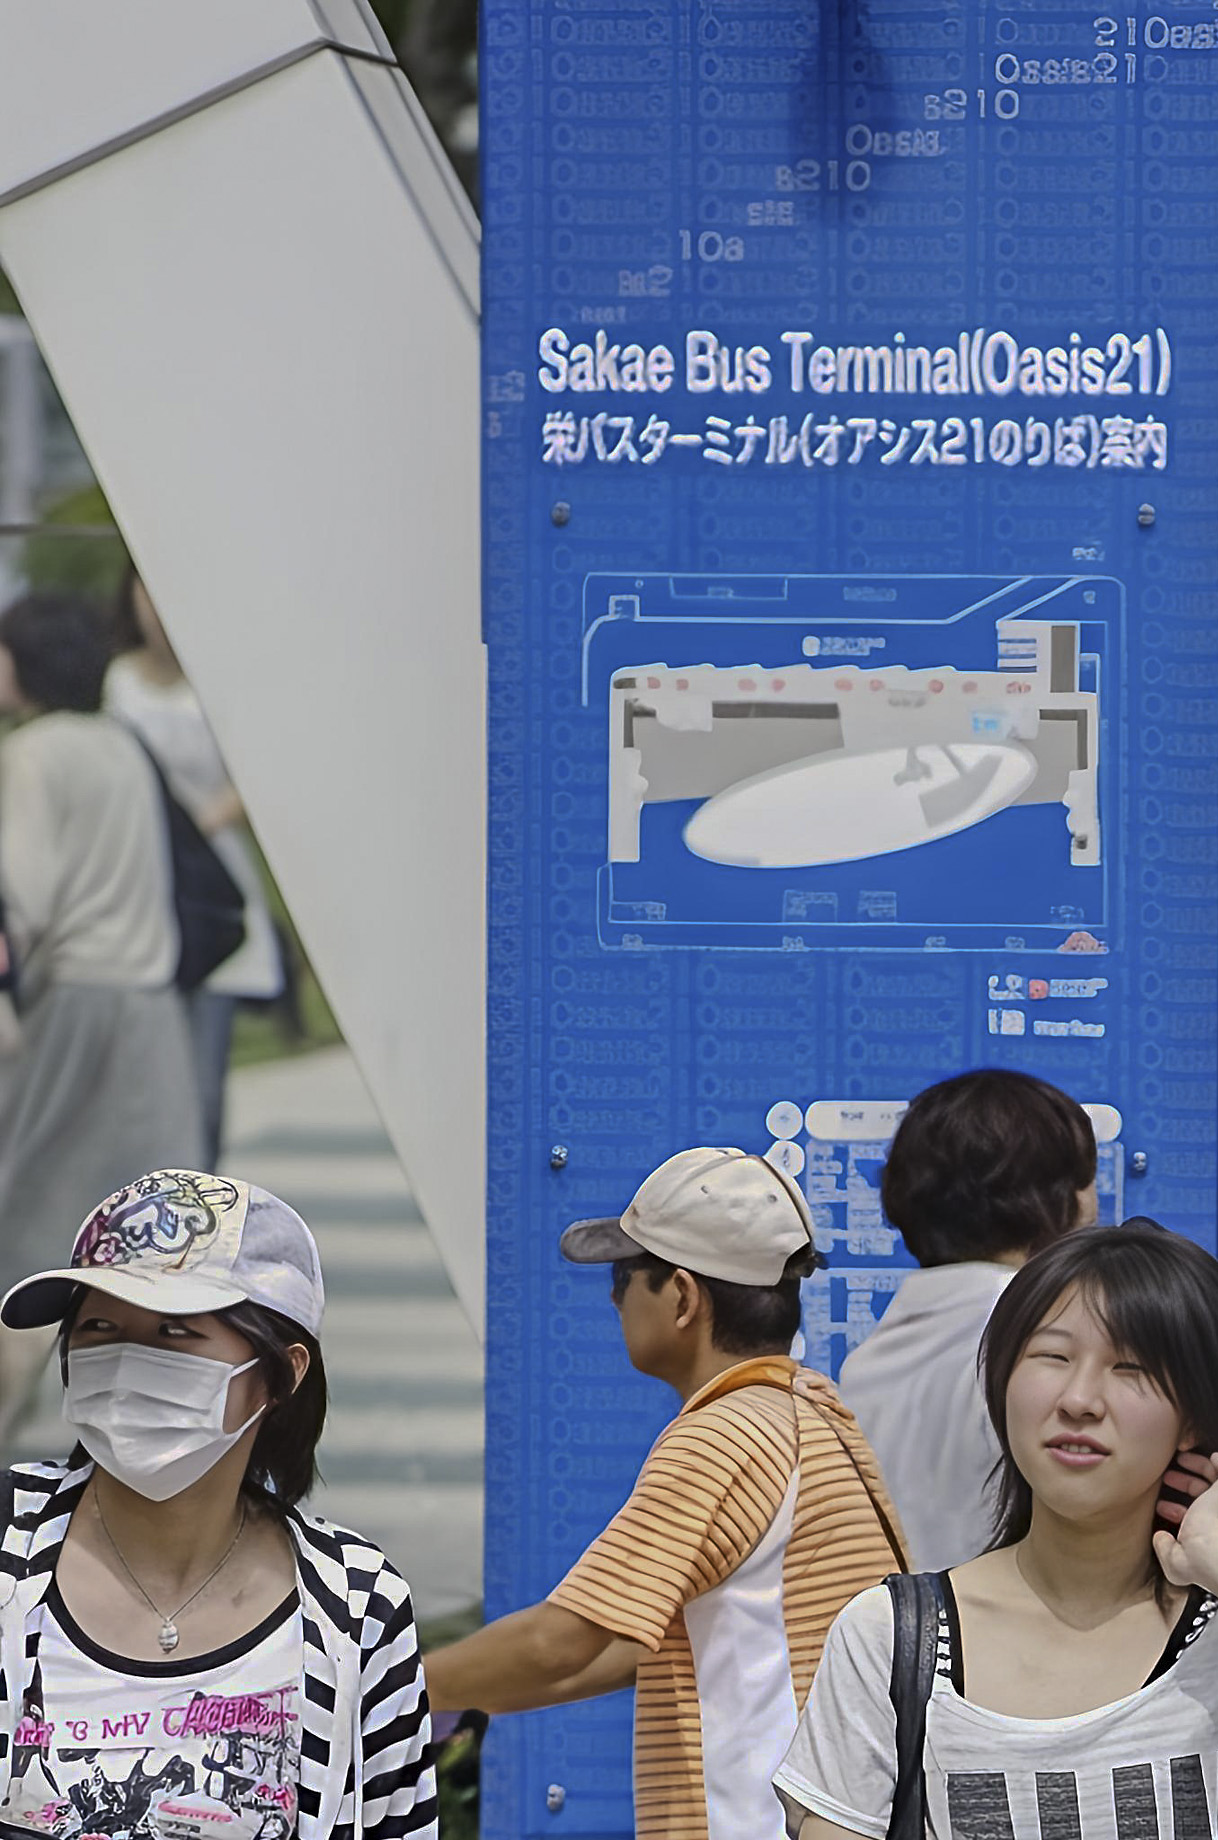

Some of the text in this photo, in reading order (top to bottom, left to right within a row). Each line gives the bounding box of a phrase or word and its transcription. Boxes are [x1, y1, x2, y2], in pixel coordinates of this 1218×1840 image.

[538, 327, 1172, 395] Sakae Bus Terminal(Oasis21)
